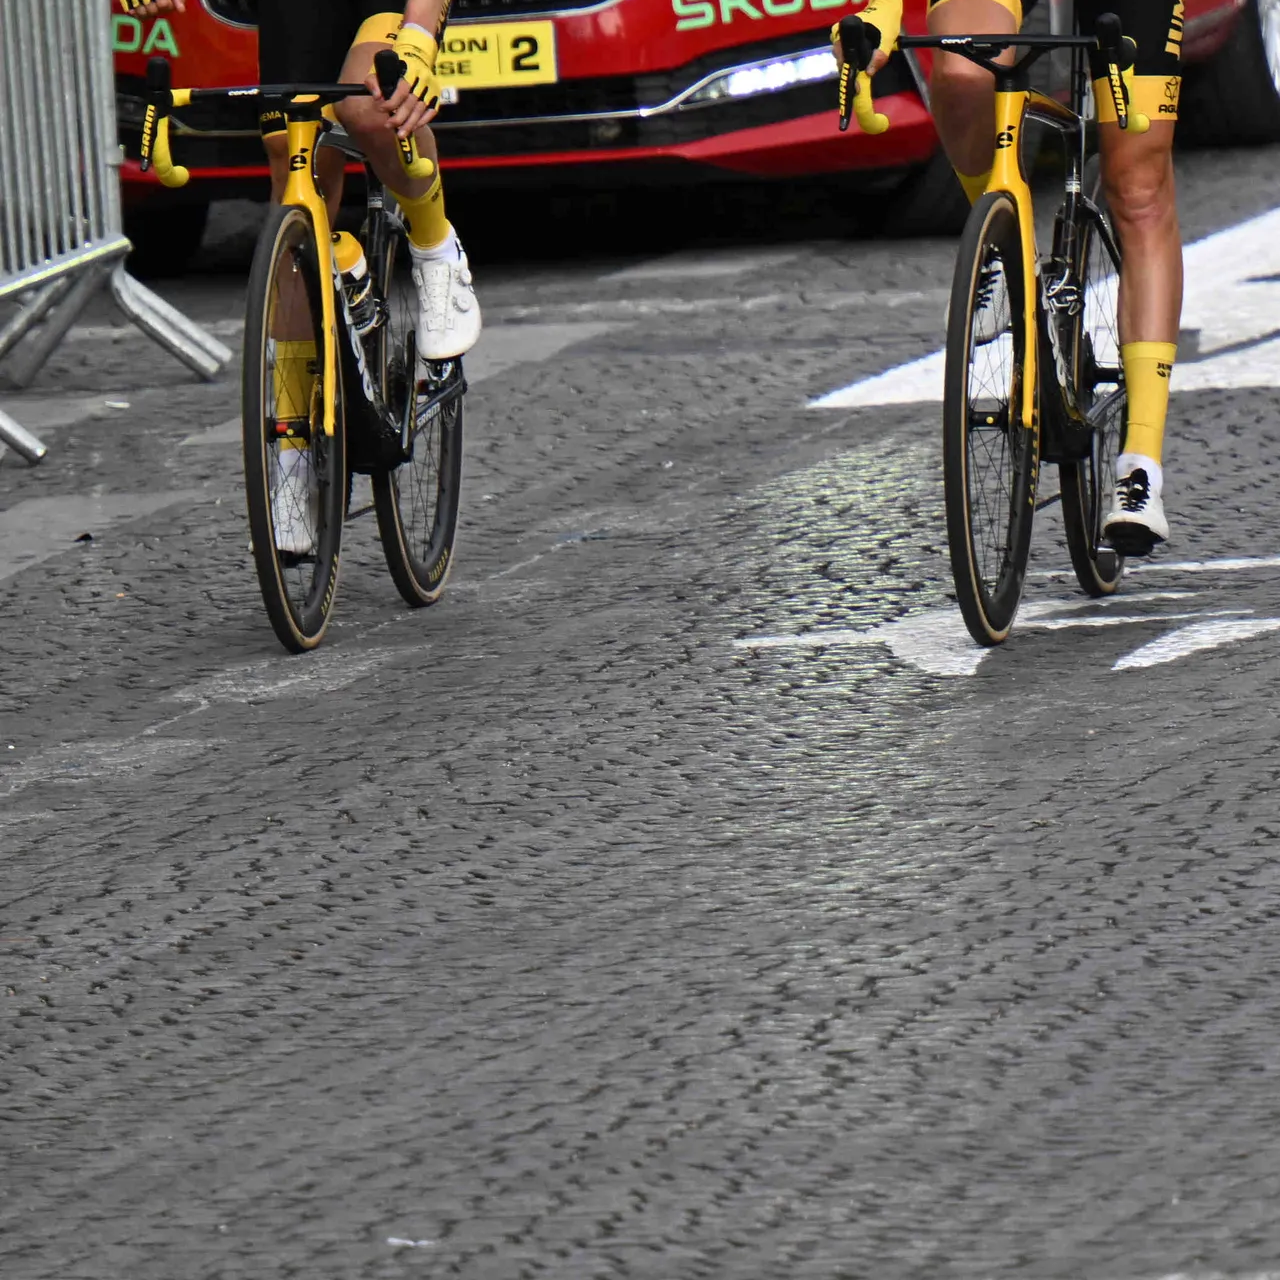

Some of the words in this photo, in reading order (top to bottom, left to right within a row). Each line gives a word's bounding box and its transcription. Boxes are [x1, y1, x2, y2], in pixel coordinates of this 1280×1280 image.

[511, 34, 541, 72] 2
[838, 62, 851, 118] SRAM
[1108, 62, 1126, 117] SRAM
[140, 104, 156, 158] SRAM
[416, 402, 441, 430] SRAM
